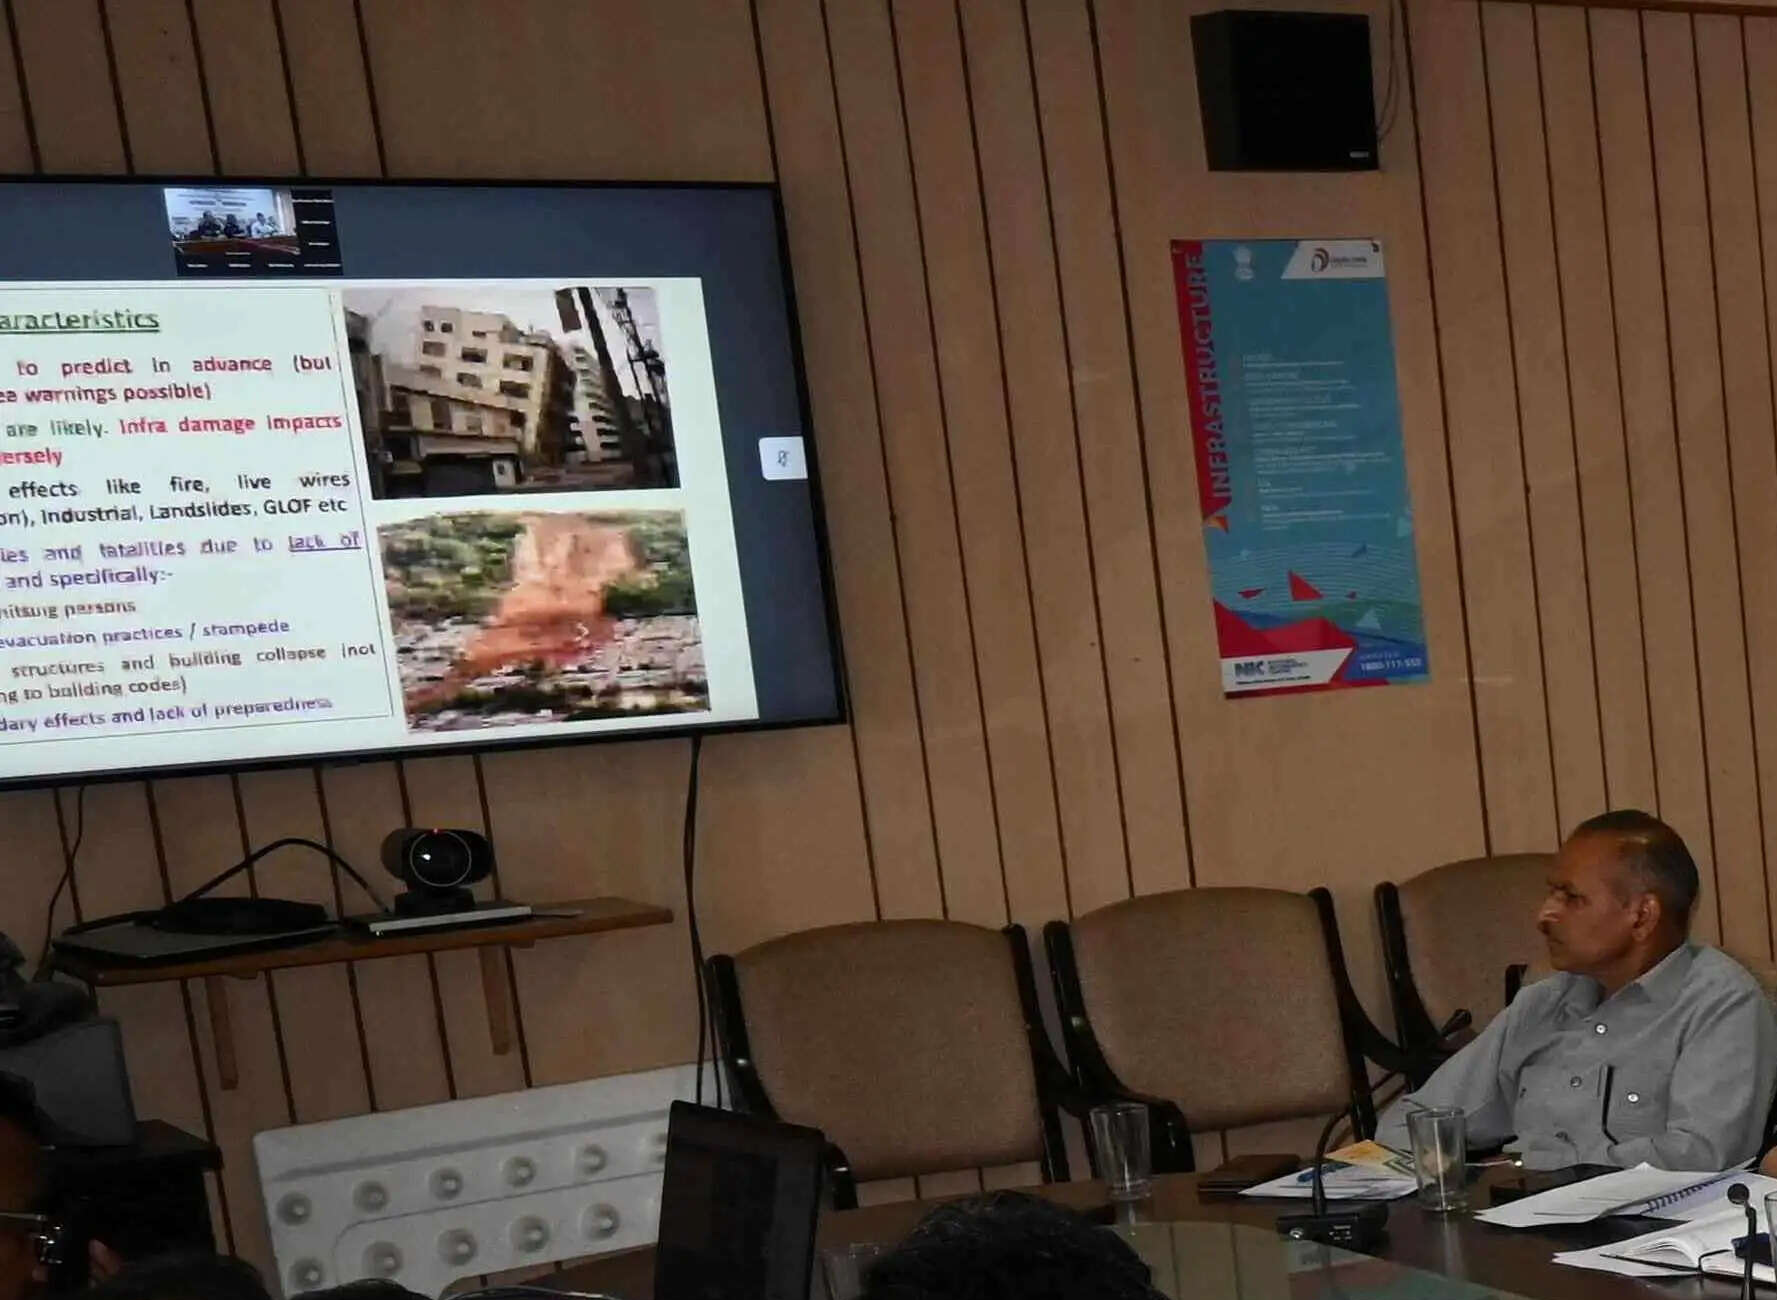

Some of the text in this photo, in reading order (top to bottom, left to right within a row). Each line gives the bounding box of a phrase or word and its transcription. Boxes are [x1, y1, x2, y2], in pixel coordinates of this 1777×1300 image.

[17, 360, 38, 376] to
[62, 357, 133, 378] predict
[193, 357, 272, 373] advance
[293, 354, 332, 374] (but
[26, 384, 117, 405] warnings
[123, 382, 212, 402] possible)
[6, 424, 38, 438] are
[119, 417, 168, 434] Infra
[179, 416, 256, 434] damage
[0, 448, 62, 467] ersely
[9, 471, 350, 499] effects like fire, live wires
[263, 498, 312, 514] GLOF
[318, 498, 348, 513] etc
[45, 544, 82, 561] and
[99, 540, 186, 559] fatalities
[201, 538, 238, 555] due
[254, 537, 273, 552] to
[288, 533, 327, 550] lack
[340, 531, 362, 549] of
[6, 572, 42, 589] and
[65, 600, 136, 618] persons
[103, 627, 183, 645] practices
[202, 619, 290, 638] stampede
[12, 660, 104, 678] structures
[121, 655, 155, 672] and
[169, 651, 242, 669] building
[256, 646, 327, 665] collapse
[24, 687, 42, 701] to
[49, 681, 123, 699] building
[128, 676, 187, 695] codes)
[44, 710, 105, 730] effects
[111, 707, 144, 724] and
[150, 704, 185, 721] lack
[191, 702, 208, 718] of
